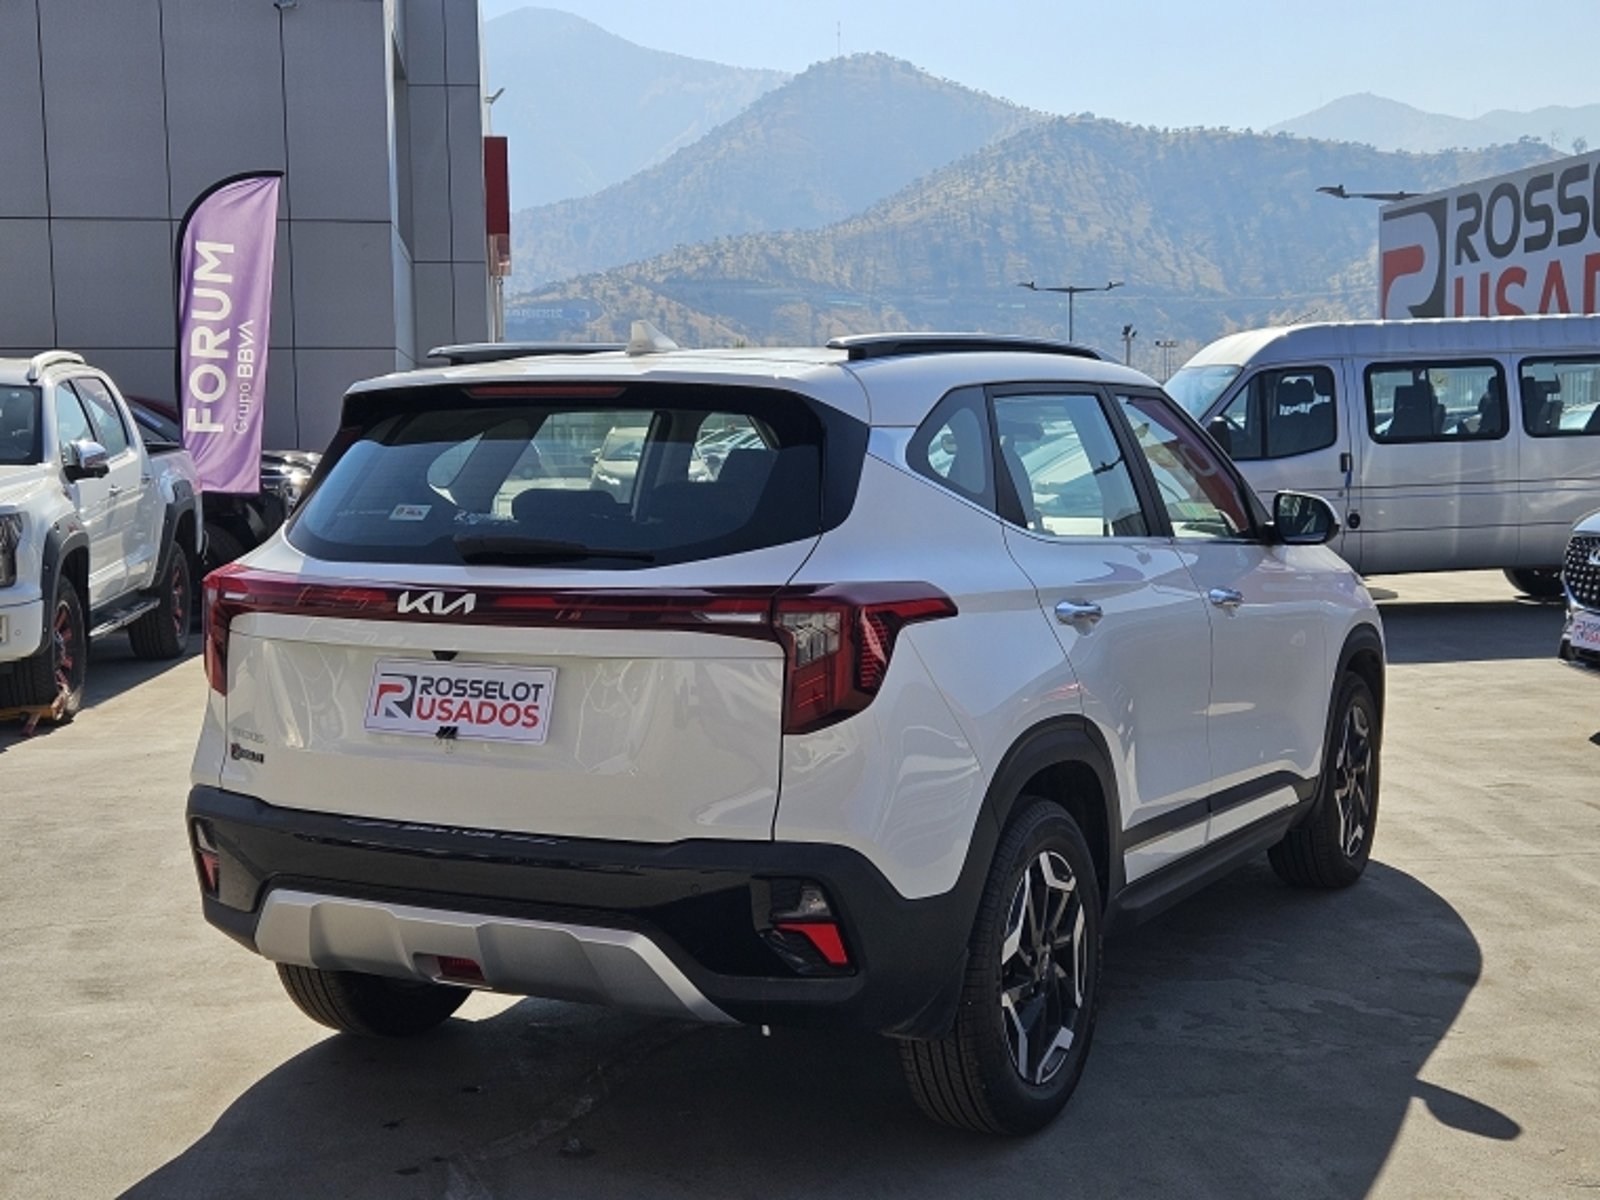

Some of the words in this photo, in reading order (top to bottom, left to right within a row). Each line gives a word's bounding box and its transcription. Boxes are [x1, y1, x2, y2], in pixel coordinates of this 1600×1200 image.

[1455, 162, 1600, 266] ROSS
[187, 240, 235, 434] FORUM
[237, 319, 255, 378] BBVA
[233, 382, 253, 434] Grupo
[397, 591, 477, 615] KIA
[416, 697, 540, 728] USADOS
[418, 676, 544, 702] ROSSELOT
